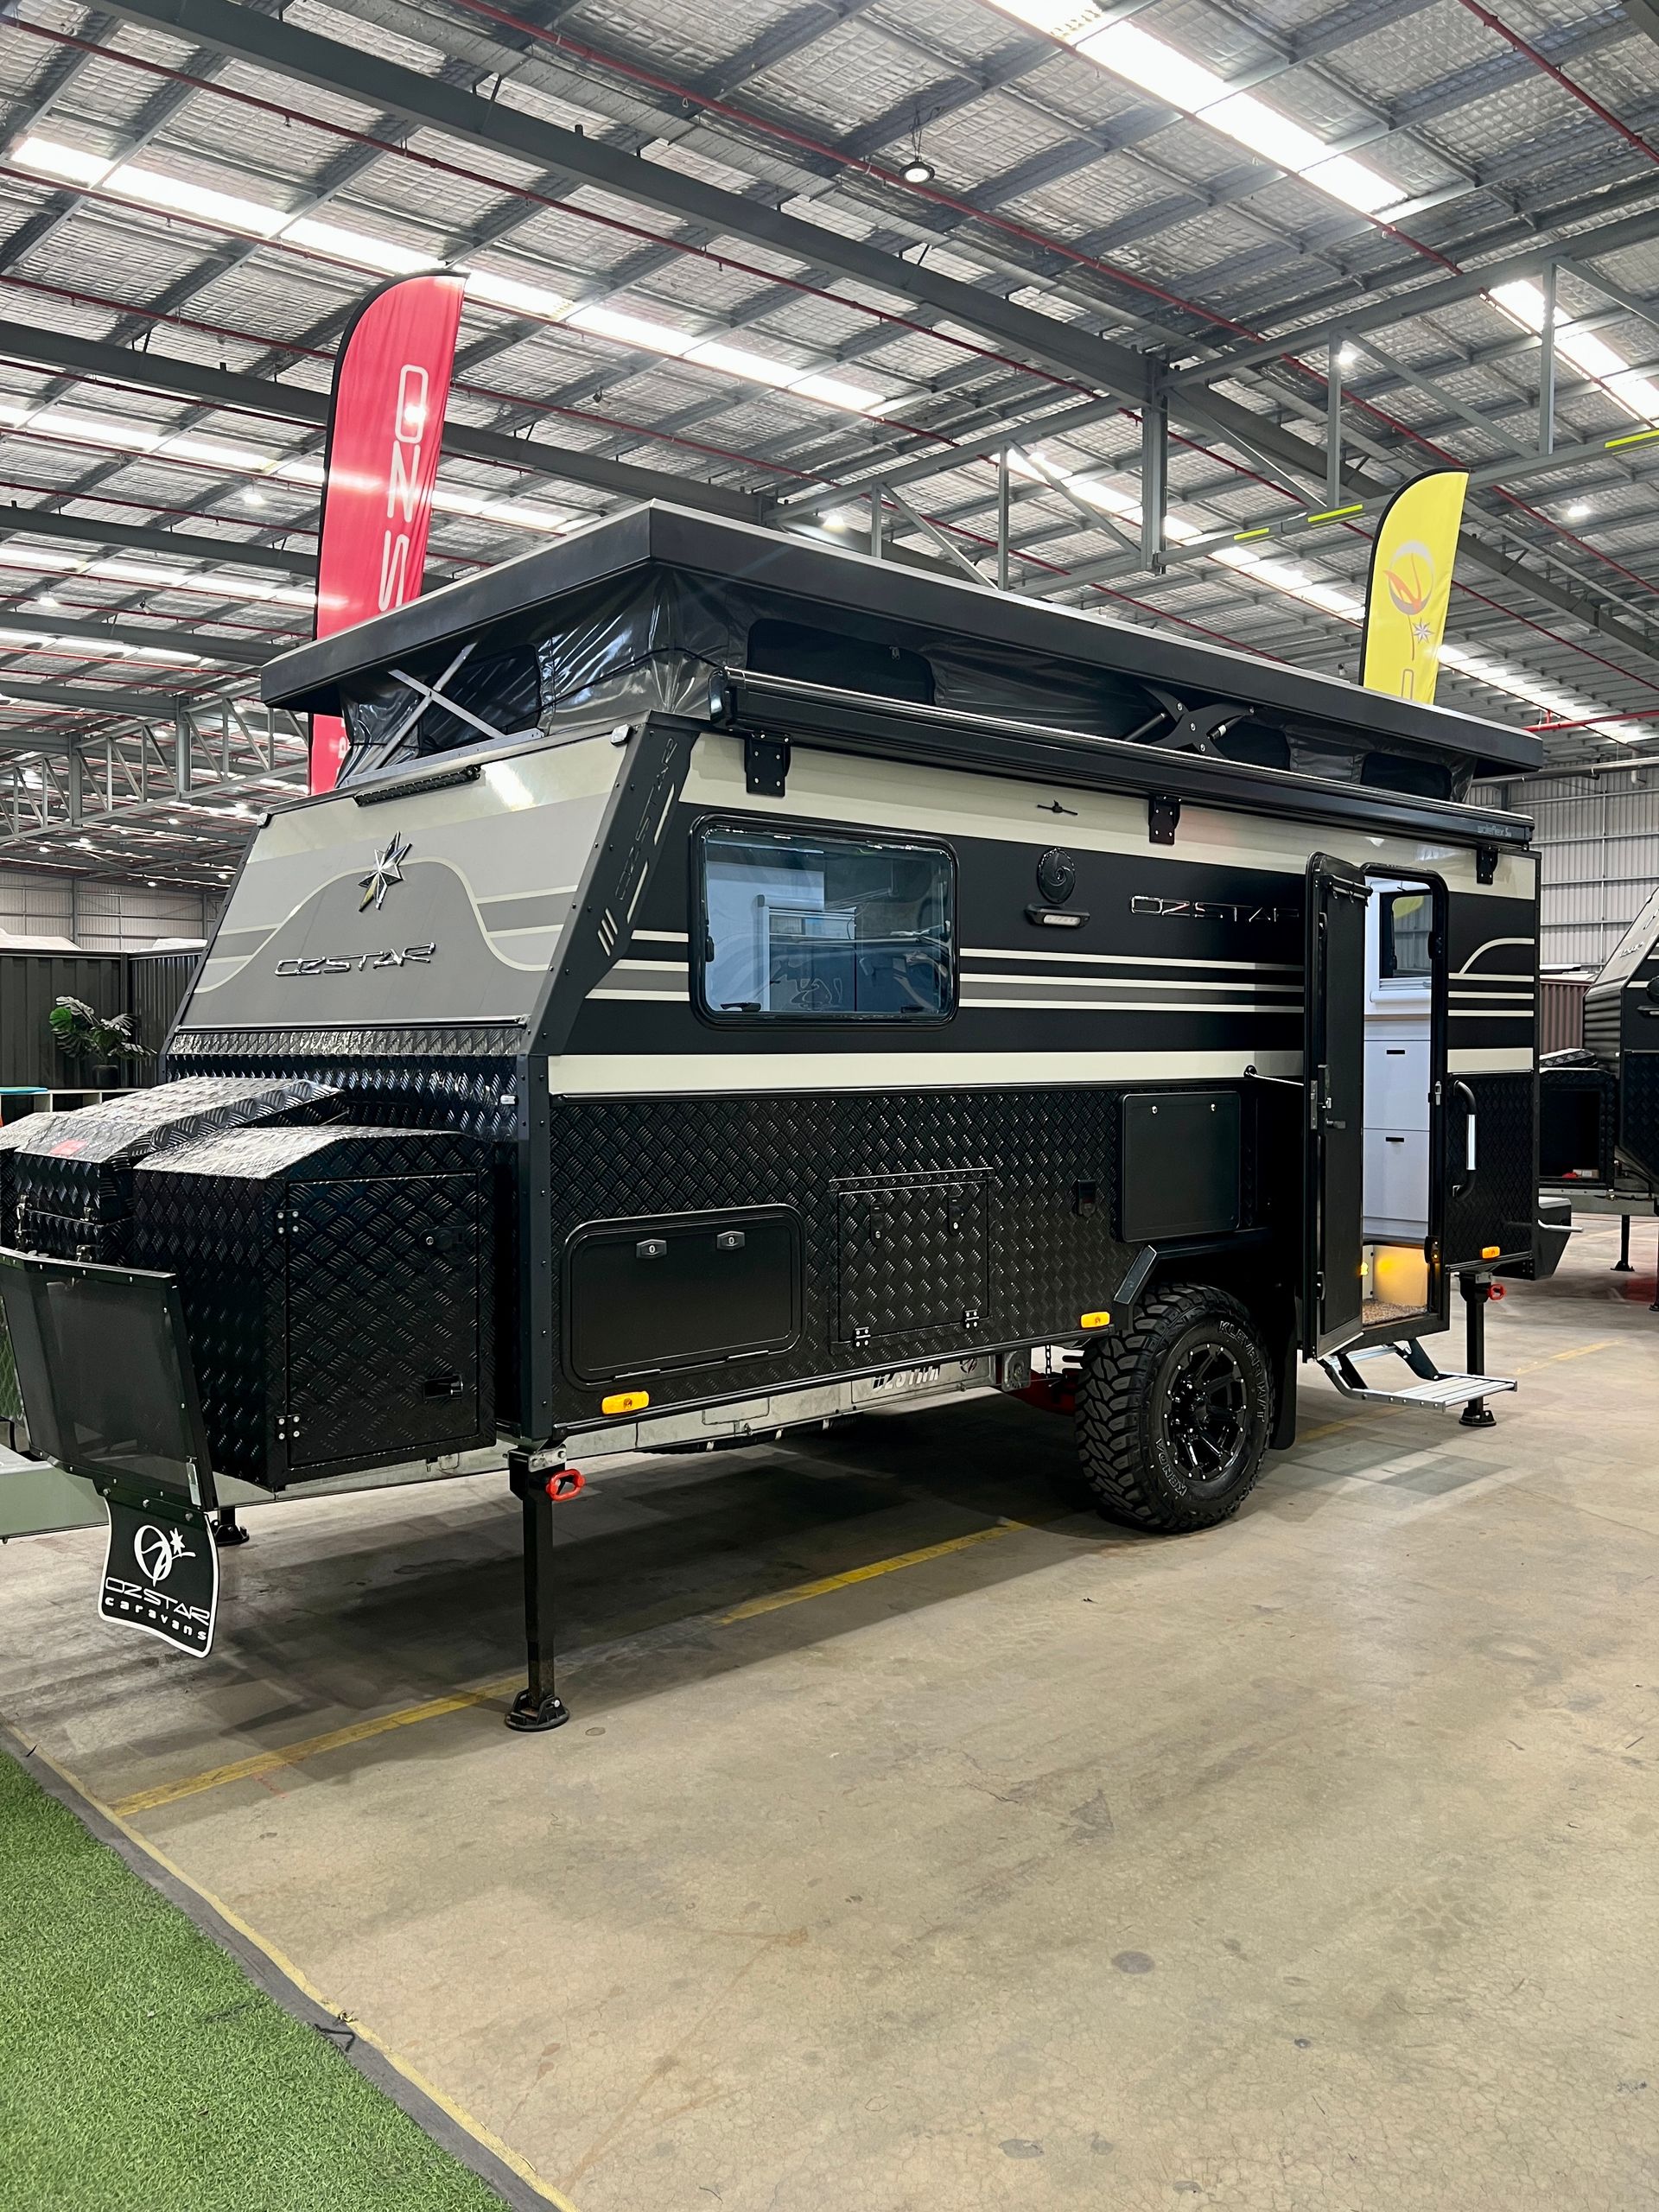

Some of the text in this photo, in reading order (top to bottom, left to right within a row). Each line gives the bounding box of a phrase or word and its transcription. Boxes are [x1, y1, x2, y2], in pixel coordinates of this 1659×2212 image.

[614, 737, 678, 900] OZSTAR
[274, 942, 436, 977] OZSTAR
[1217, 1319, 1263, 1377] KLEVER
[1155, 1437, 1188, 1497] KENDA
[105, 1576, 211, 1627] OZSTAR
[105, 1596, 207, 1642] caravans
